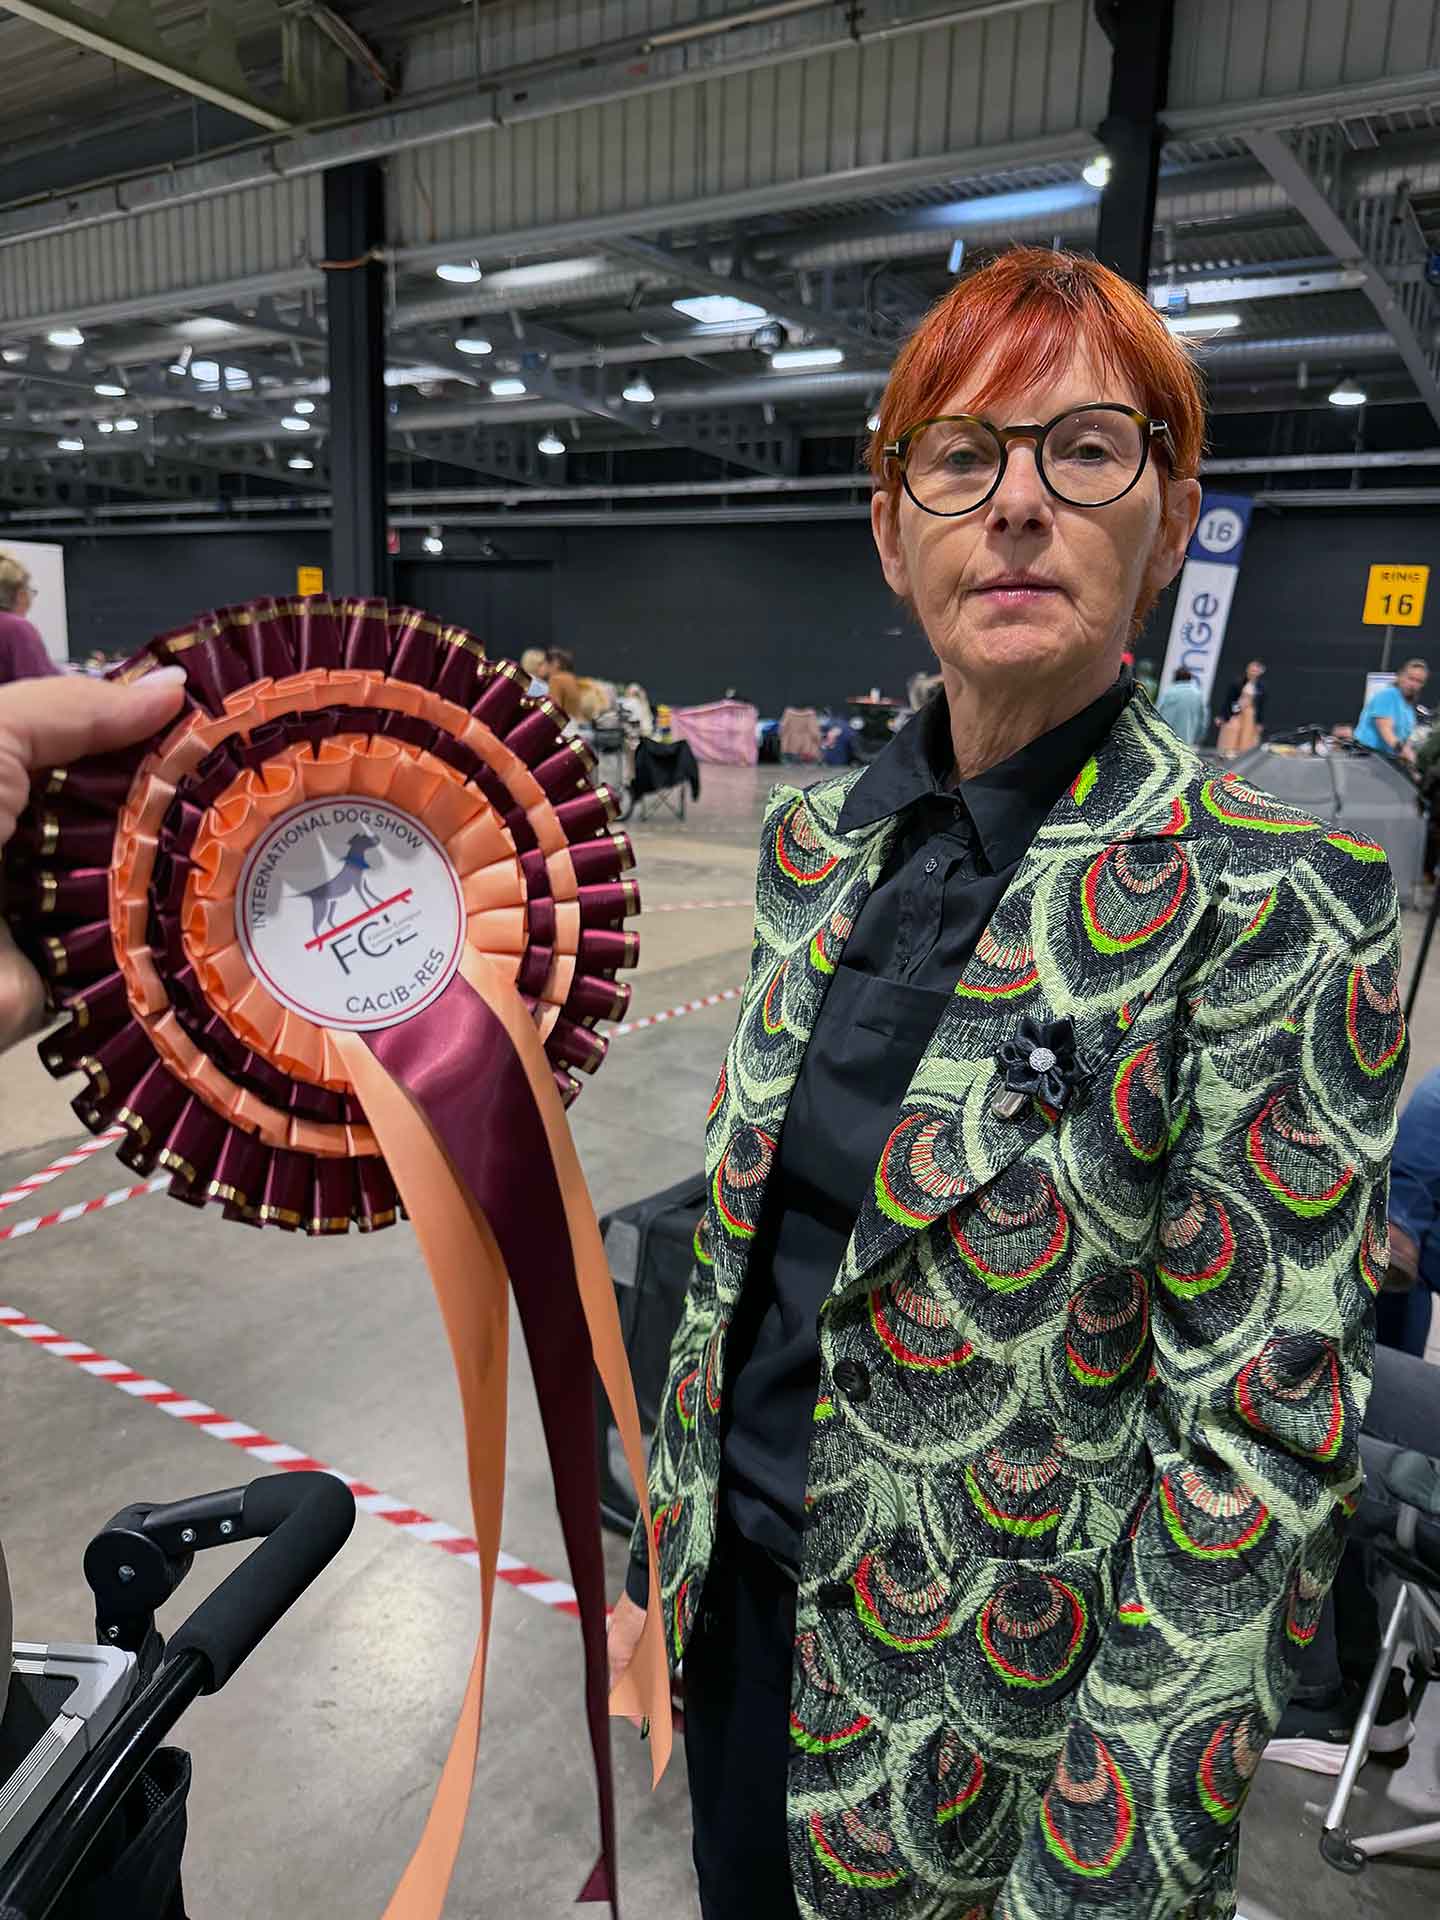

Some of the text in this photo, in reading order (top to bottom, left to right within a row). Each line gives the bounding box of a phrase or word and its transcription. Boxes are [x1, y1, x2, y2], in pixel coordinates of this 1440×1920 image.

[1204, 520, 1233, 543] 16
[1381, 593, 1415, 616] 16
[252, 809, 424, 929] INTERNATIONAL DOG SHOW
[346, 947, 445, 1014] CACIB-RES
